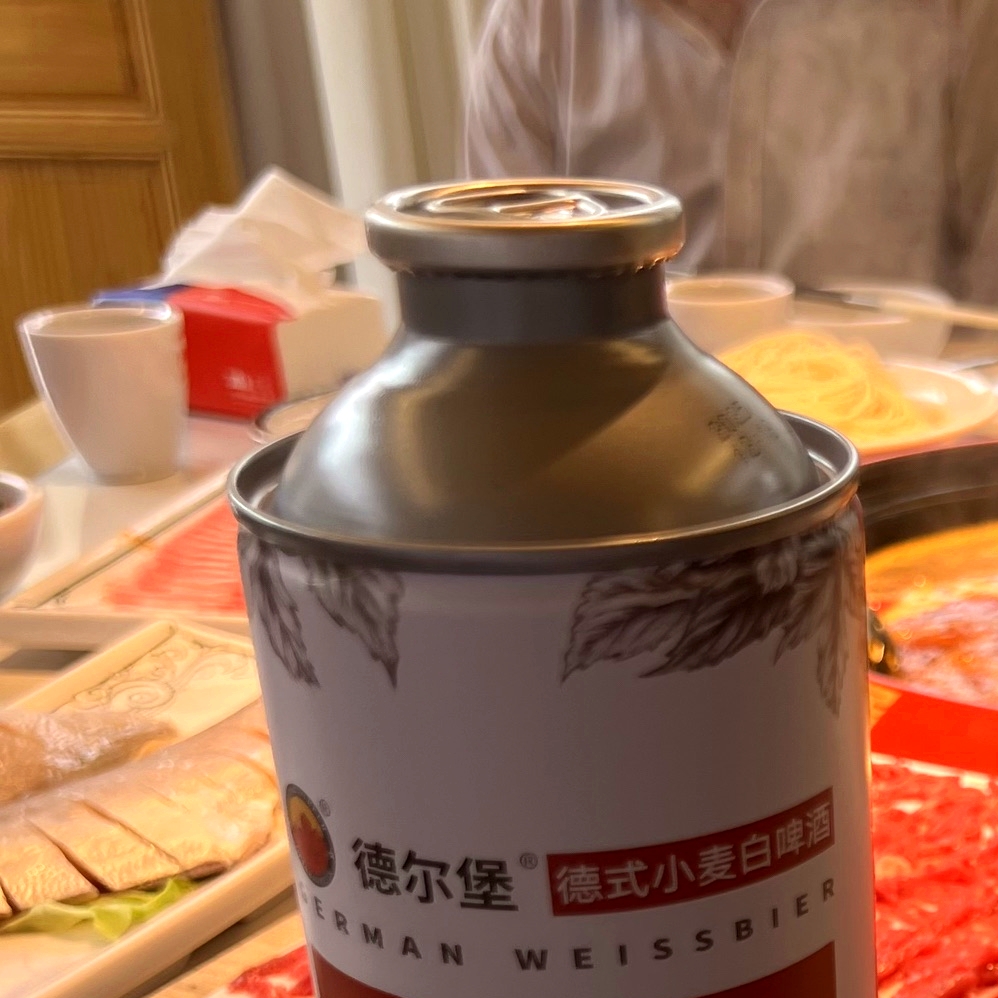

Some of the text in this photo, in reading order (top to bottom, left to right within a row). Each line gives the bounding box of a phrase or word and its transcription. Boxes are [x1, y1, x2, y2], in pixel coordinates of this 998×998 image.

[351, 837, 519, 912] 德尔堡
[556, 802, 832, 906] 德式小麦白啤酒
[515, 878, 834, 971] WEISSBIER
